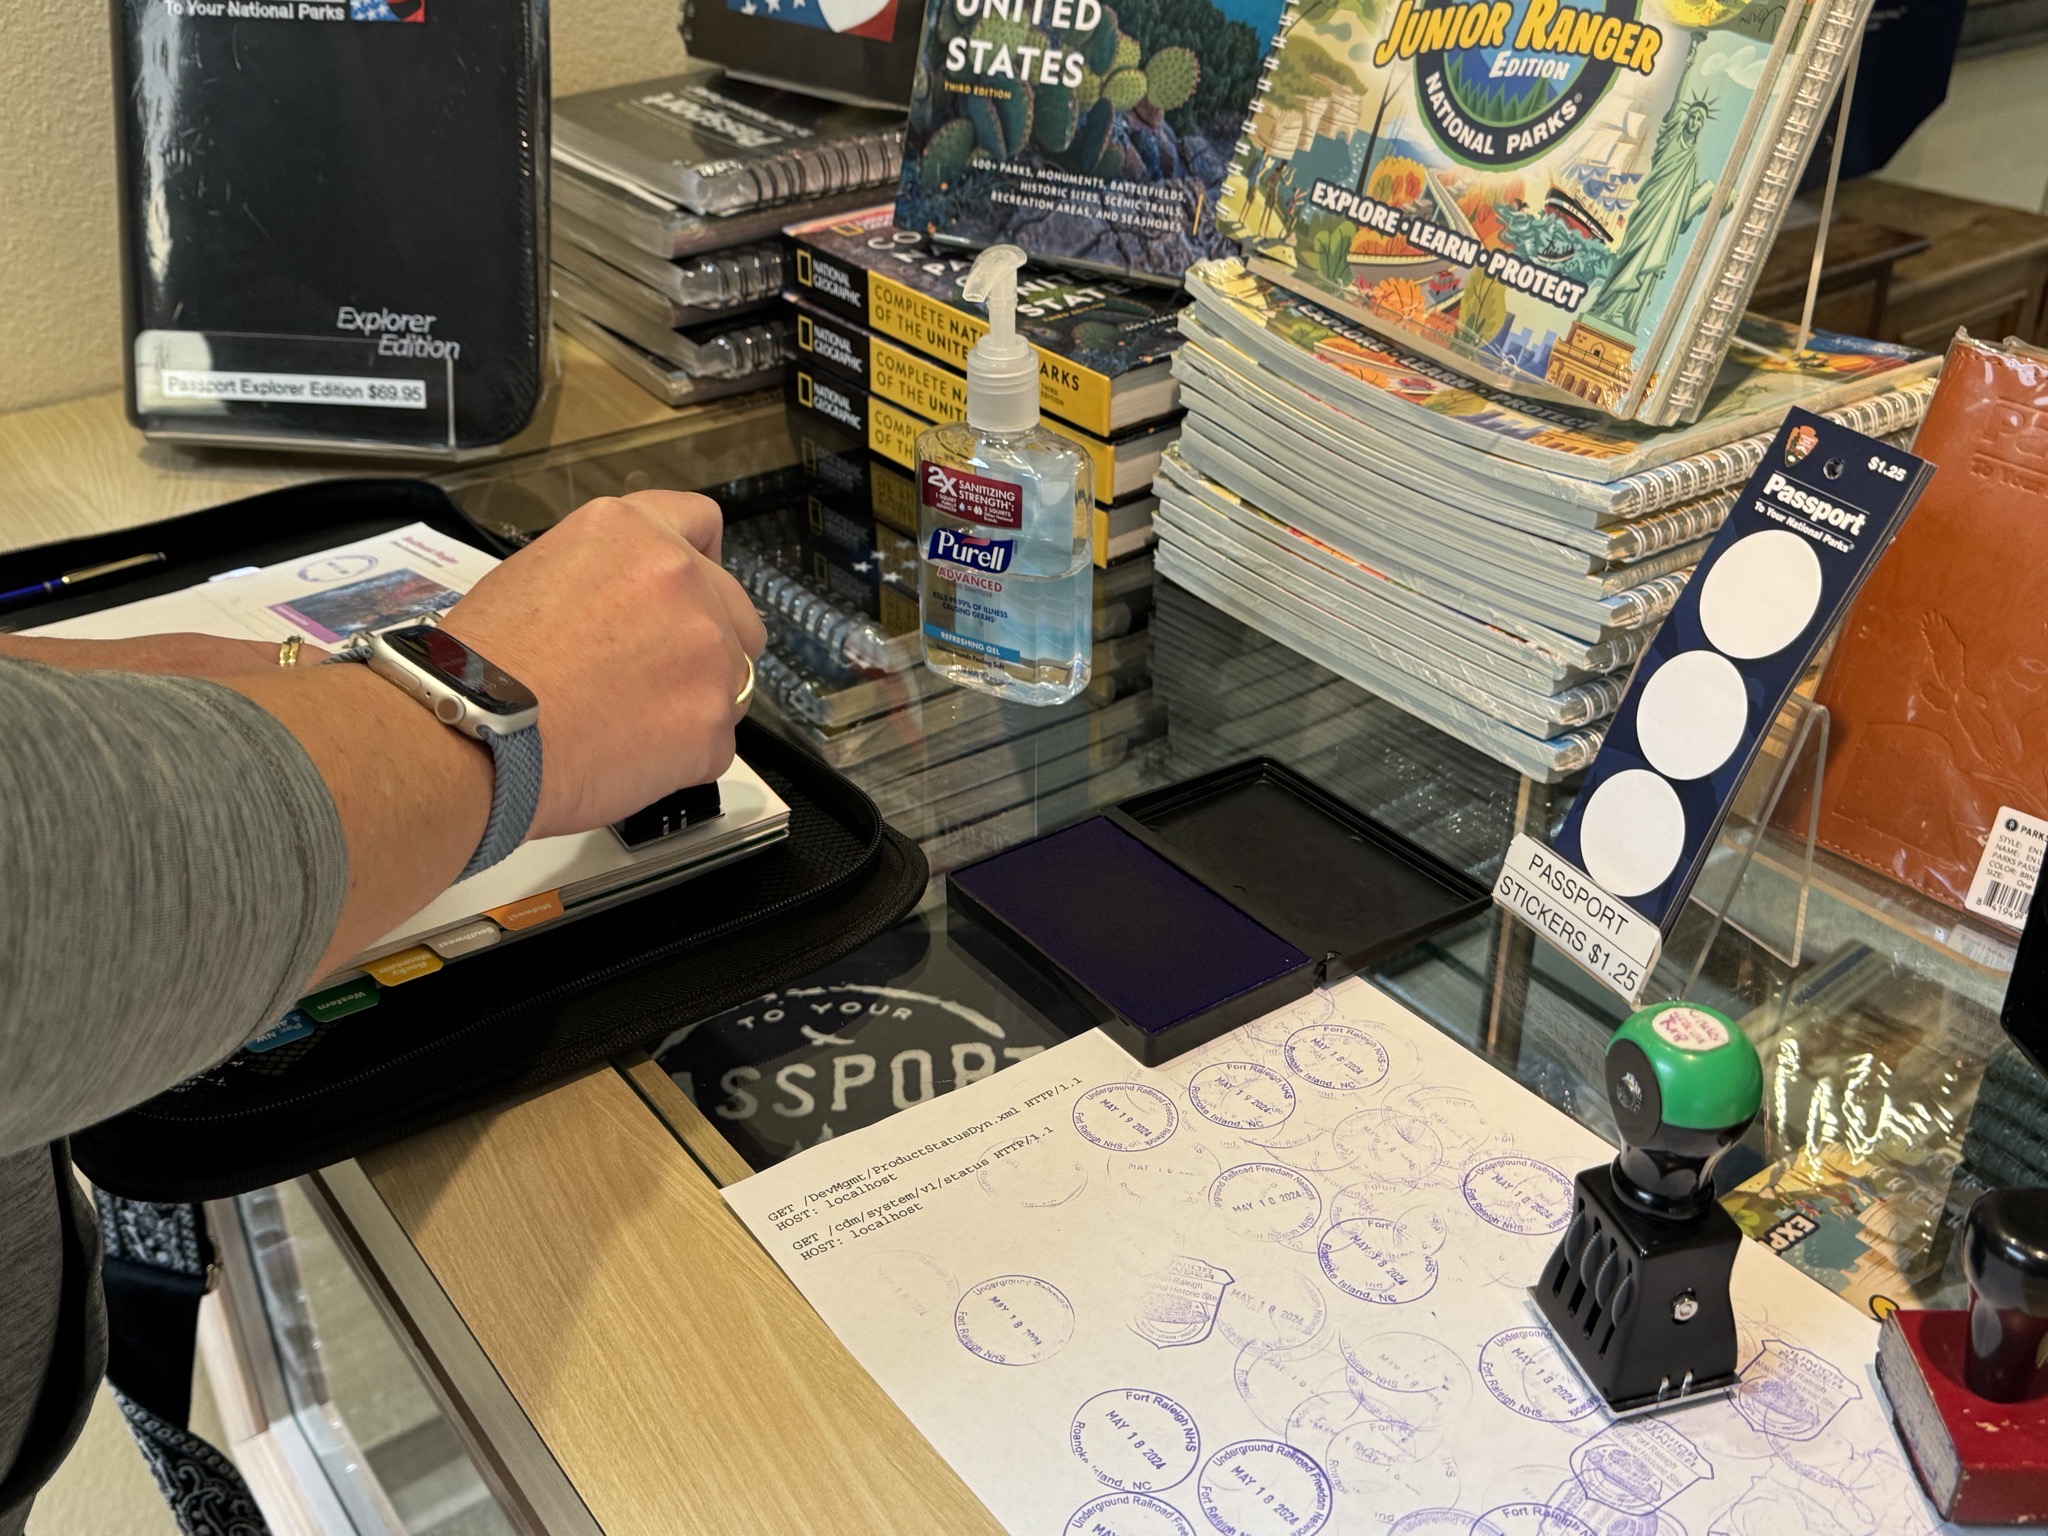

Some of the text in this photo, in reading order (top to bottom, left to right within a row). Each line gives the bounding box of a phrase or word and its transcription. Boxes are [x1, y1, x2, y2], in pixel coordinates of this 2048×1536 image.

[165, 1, 345, 21] To Your National Parks
[956, 0, 1102, 31] UNITED
[1374, 0, 1661, 74] JUNIOR RANGER
[946, 37, 1085, 88] STATES
[944, 81, 1012, 100] THIRD EDITION
[1425, 71, 1495, 155] NATIONAL
[1020, 181, 1067, 198] HISTORIC
[1104, 195, 1144, 211] SCENIC
[990, 191, 1053, 211] RECREATION
[1096, 209, 1118, 222] AND
[1121, 211, 1182, 233] SEASHORES
[1312, 182, 1585, 309] EXPLORE LEARN PROTECT
[812, 259, 851, 287] NATIONAL
[812, 274, 862, 308] GEOGRAPHIC
[1017, 282, 1132, 317] STATE
[336, 306, 437, 336] Explorer
[874, 284, 944, 329] COMPLETE
[377, 333, 460, 360] Edition
[813, 325, 852, 353] NATIONAL
[875, 305, 892, 325] OF
[897, 313, 922, 340] THE
[927, 330, 968, 360] UNITE
[813, 338, 863, 373] GEOGRAPHIC
[1298, 304, 1600, 430] EXPLORE LEARN PROTECT
[167, 375, 237, 397] Passport
[241, 378, 305, 398] Explorer
[310, 381, 363, 399] Edition
[876, 351, 947, 396] COMPLETE
[1039, 361, 1080, 392] ARKS
[812, 382, 852, 411] NATIONAL
[876, 371, 893, 391] OF
[898, 381, 923, 406] THE
[929, 394, 967, 421] UNIT
[812, 396, 862, 431] GEOGRAPHIC
[875, 430, 891, 447] OF
[927, 466, 958, 498] 2X
[1867, 455, 1907, 482] $1.25
[959, 480, 1016, 502] SANITIZING
[1762, 473, 1867, 537] Passport
[1754, 500, 1766, 513] To
[1765, 505, 1789, 524] Your
[1785, 515, 1825, 543] National
[938, 530, 1005, 571] Purell
[937, 566, 1002, 592] ADVANCED
[933, 591, 948, 601] KILLS
[983, 606, 1008, 619] ILLNESS
[942, 602, 970, 617] CAUSING
[941, 631, 984, 651] REFRESHING
[986, 647, 1001, 656] GEL
[1995, 843, 2020, 857] NAME:
[1998, 834, 2022, 849] STYLE:
[1988, 860, 2016, 875] COLOR:
[1992, 852, 2040, 874] PARKS PASS
[1529, 853, 1629, 935] PASSPORT
[2016, 879, 2033, 891] One
[507, 903, 552, 922] Midwest
[438, 926, 495, 949] Southwest
[1500, 876, 1640, 991] STICKERS $1.25
[391, 961, 427, 977] Rocky
[316, 991, 367, 1011] Western
[737, 1001, 914, 1031] TO YOUR
[1346, 1028, 1377, 1047] Raleigh
[671, 1043, 1046, 1120] SSPOR
[1226, 1063, 1247, 1071] Fort
[1085, 1084, 1166, 1104] Underground Railroad
[1100, 1099, 1120, 1112] MAY
[1075, 1112, 1123, 1150] Fort Raleigh NHS
[767, 1204, 796, 1223] GET
[803, 1106, 1021, 1208] /DevMgmt/ProductStatusDyn.xml
[1023, 1076, 1083, 1109] HTTP/1.1
[791, 1235, 820, 1252] GET
[828, 1157, 991, 1237] /cdm/system/v1/status
[992, 1126, 1055, 1160] HTTP/1.1
[1222, 1165, 1294, 1183] Railroad Freedom
[774, 1172, 899, 1232] HOST: localhost
[1231, 1190, 1302, 1214] MAY 2024
[800, 1202, 925, 1262] HOST: localhost
[1502, 1221, 1524, 1232] NHS
[1172, 1276, 1204, 1289] Raleigh
[1493, 1330, 1553, 1347] Underground
[1375, 1375, 1399, 1389] NHS
[1482, 1361, 1542, 1418] Fort Raleigh NHS
[1511, 1347, 1578, 1405] MAY 2024
[1125, 1391, 1197, 1453] Fort Raleigh NHS
[1105, 1409, 1167, 1470] MAY 2024
[1631, 1432, 1678, 1470] Fort Raleigh
[1072, 1420, 1152, 1491] Roanoke NC
[1212, 1444, 1317, 1474] Underground Railroad
[1230, 1465, 1257, 1486] MAY
[1665, 1472, 1684, 1488] Site
[1201, 1485, 1214, 1504] Fort
[1071, 1495, 1175, 1529] Underground Railroad
[1502, 1506, 1529, 1519] Fort
